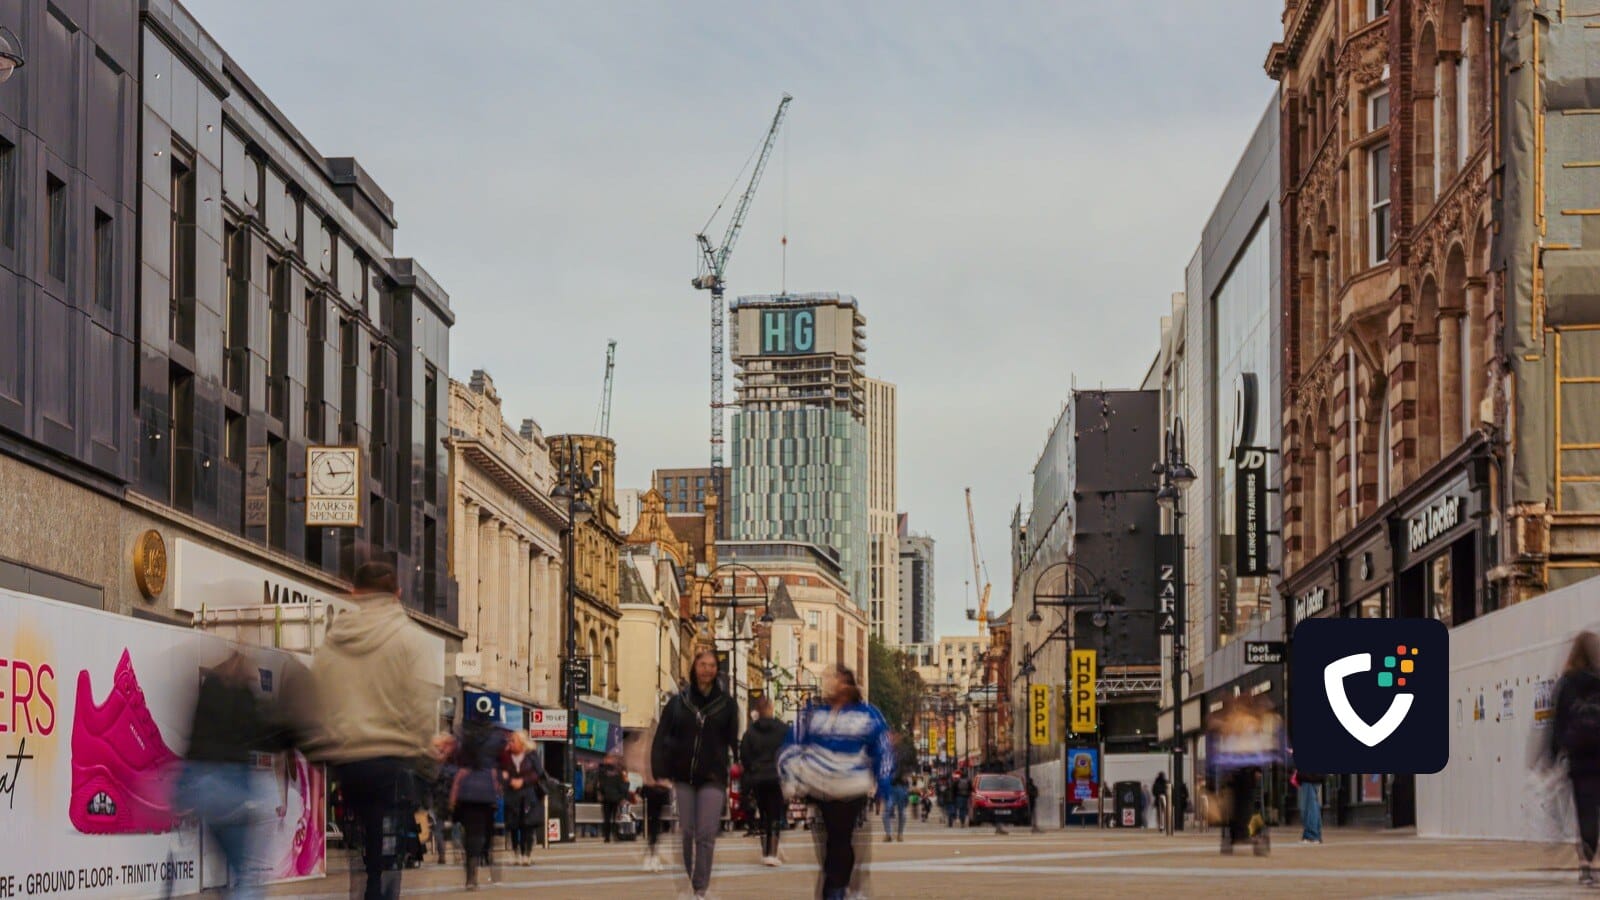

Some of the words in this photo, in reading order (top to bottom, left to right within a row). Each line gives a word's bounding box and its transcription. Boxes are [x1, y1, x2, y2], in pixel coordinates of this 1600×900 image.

[1239, 451, 1265, 469] JD
[310, 501, 347, 511] MARKS
[1247, 473, 1257, 522] TRAINERS
[310, 511, 354, 521] SPENCER
[1409, 518, 1427, 553] Foot
[1428, 496, 1460, 540] Locker
[1247, 532, 1257, 556] KING
[1160, 564, 1175, 630] ZARA
[1306, 586, 1324, 617] Locker
[1247, 643, 1270, 653] Foot
[1247, 653, 1281, 663] Locker
[1076, 656, 1091, 723] HPPH
[1034, 689, 1045, 738] HPPH
[26, 869, 75, 895] GROUND
[78, 866, 113, 889] FLOOR
[121, 863, 158, 884] TRINITY
[160, 860, 194, 880] CENTRE
